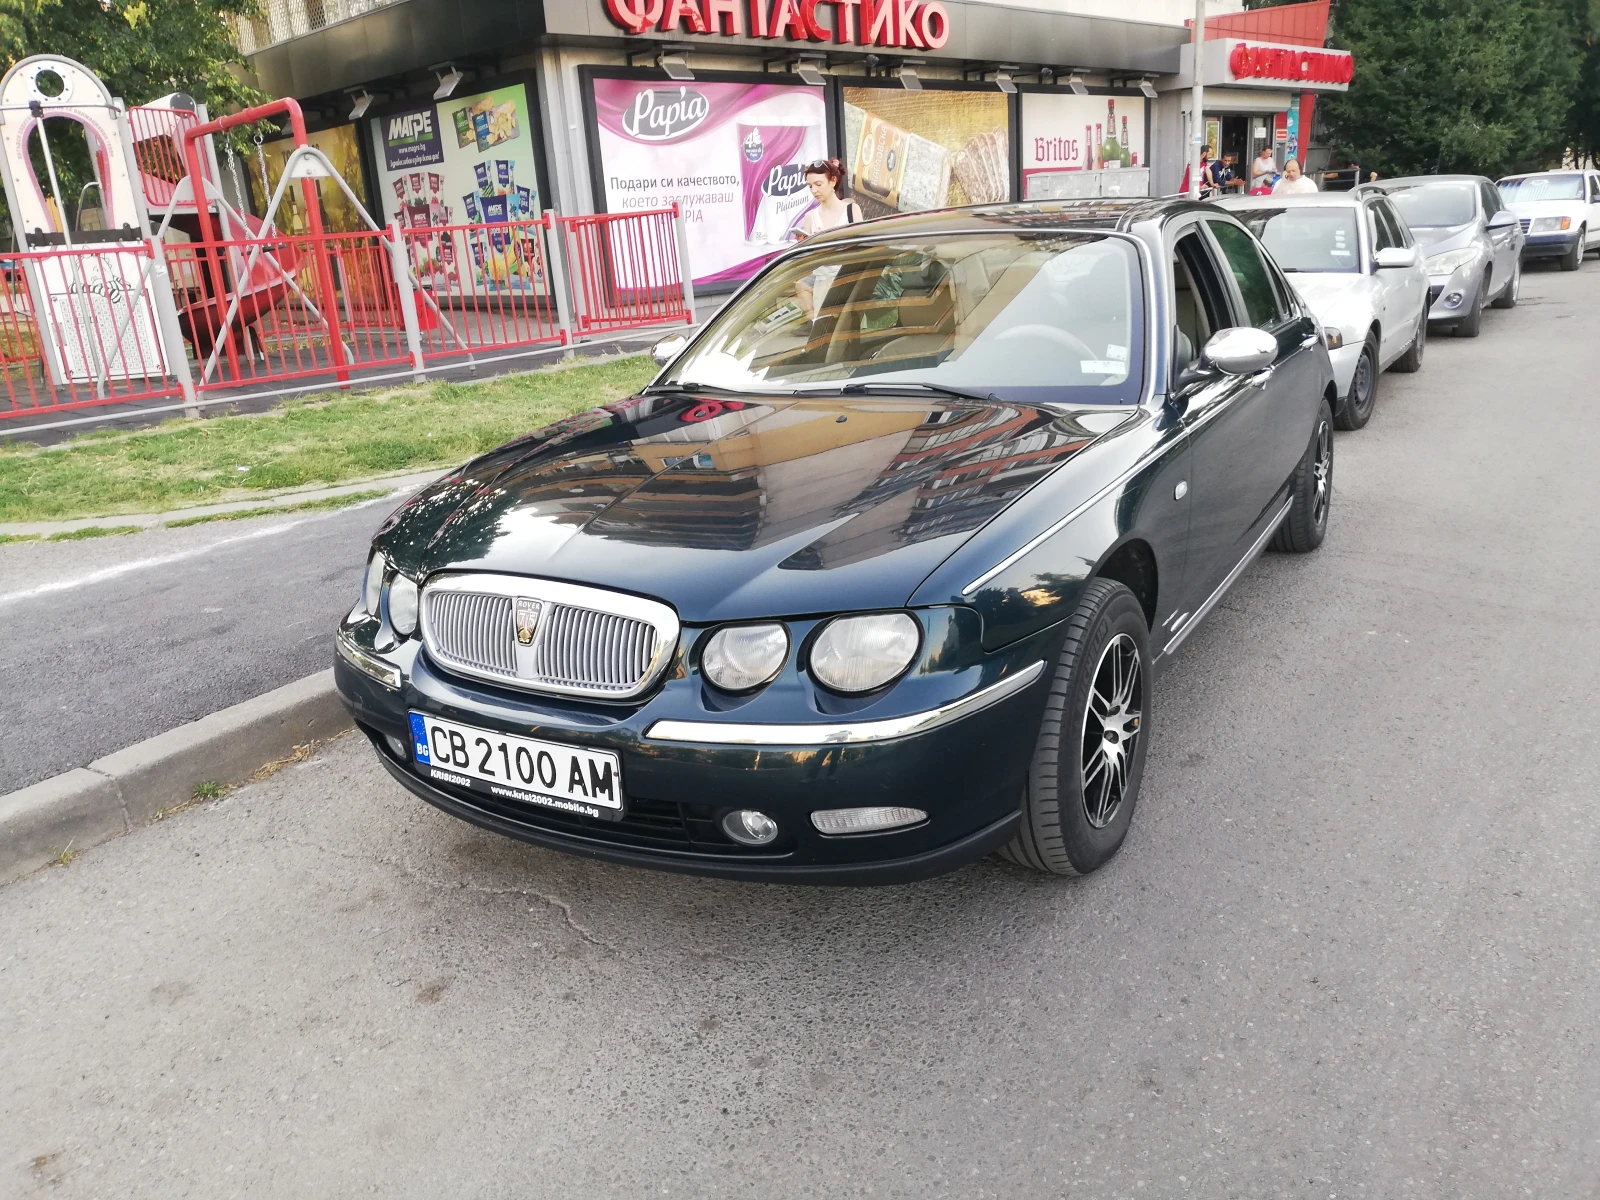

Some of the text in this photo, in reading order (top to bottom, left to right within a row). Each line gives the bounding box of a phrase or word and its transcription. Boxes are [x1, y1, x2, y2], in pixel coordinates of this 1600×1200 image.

[607, 0, 950, 49] ФАНТАСТИКО
[1230, 43, 1354, 84] ФАНТАСТИКО
[632, 86, 706, 137] Papia
[1034, 136, 1079, 162] Britos
[610, 175, 740, 192] Подари си качеството,
[622, 196, 659, 209] което
[776, 195, 809, 215] Platinum
[518, 600, 540, 611] ROVER
[416, 742, 429, 757] BG
[430, 725, 614, 802] CB 2100 AM
[430, 768, 471, 788] KRISI2002
[490, 785, 600, 818] www.krisi2002.mobile.bg
